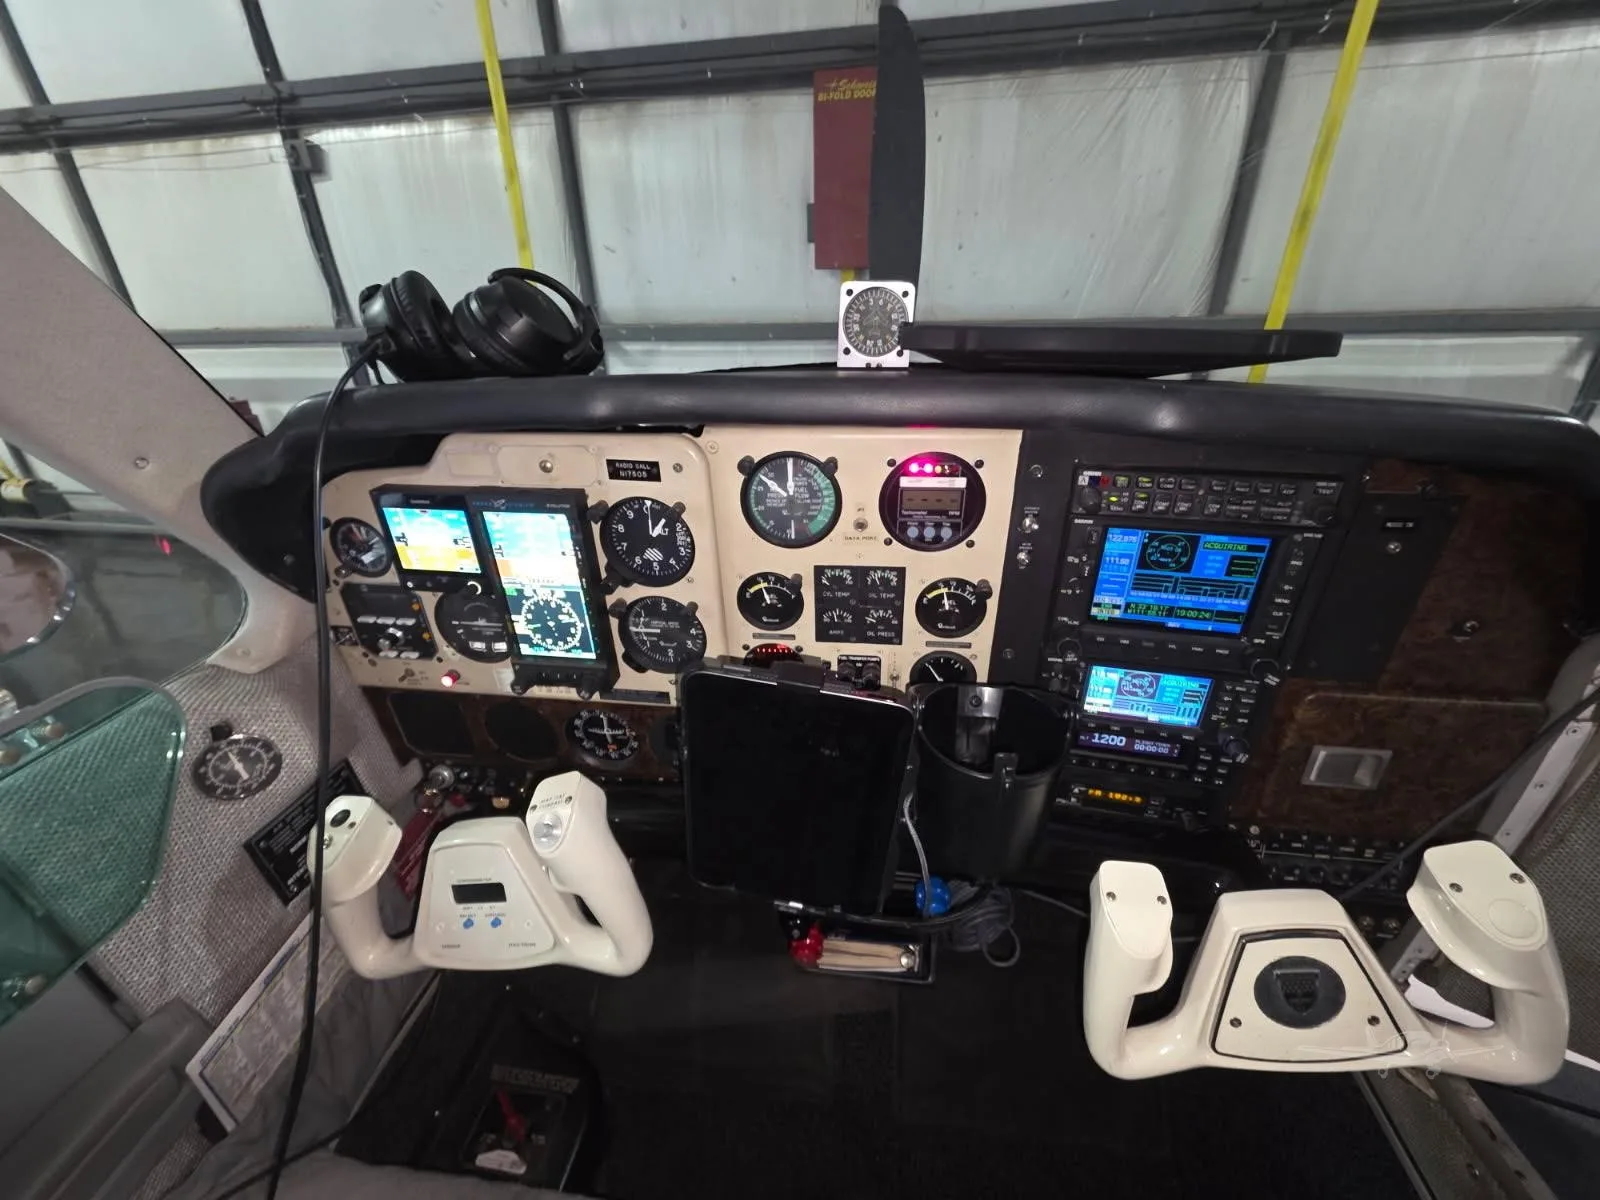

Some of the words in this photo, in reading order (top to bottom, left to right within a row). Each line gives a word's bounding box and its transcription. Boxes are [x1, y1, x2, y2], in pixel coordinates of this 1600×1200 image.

[626, 511, 634, 519] 9
[618, 524, 625, 533] 8
[676, 523, 682, 532] 2
[621, 543, 627, 551] 7
[1204, 542, 1249, 551] ACQUIRING
[679, 547, 686, 556] 3
[635, 556, 642, 565] 6
[653, 562, 660, 571] 5
[661, 603, 667, 611] 2
[690, 628, 696, 636] 4
[686, 640, 693, 649] 3
[667, 649, 674, 657] 2
[1092, 733, 1126, 746] 1200
[1134, 744, 1169, 754] 00:00:00
